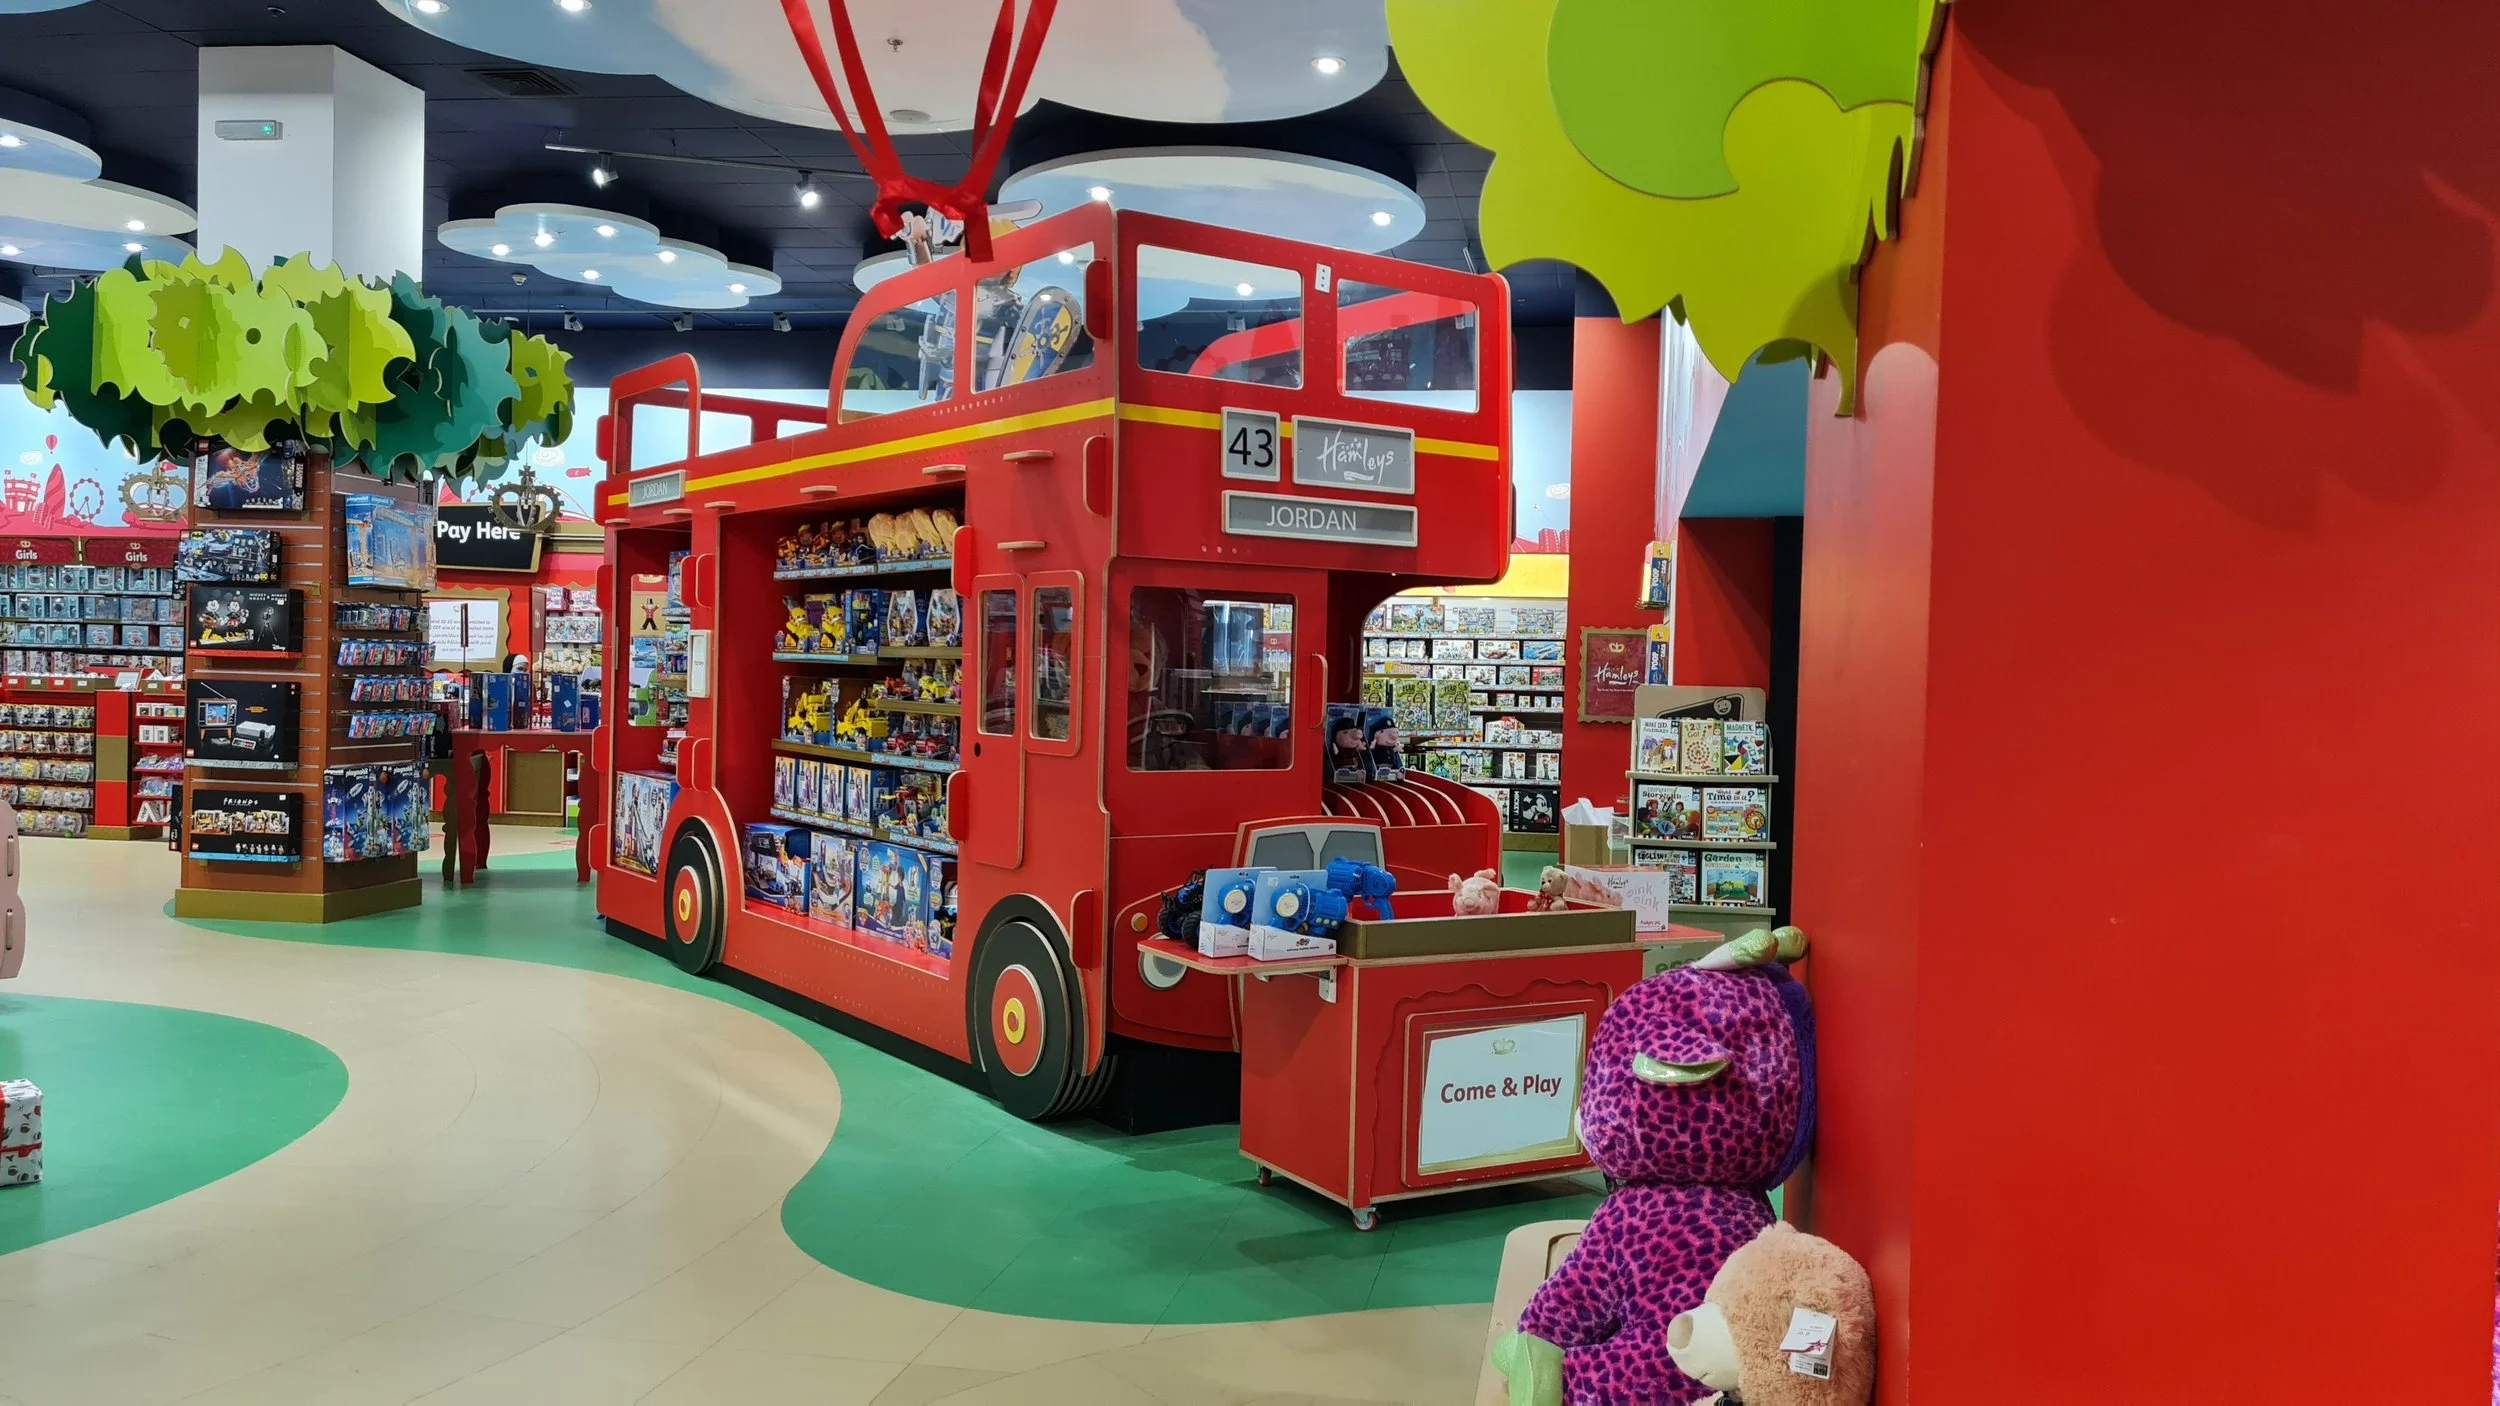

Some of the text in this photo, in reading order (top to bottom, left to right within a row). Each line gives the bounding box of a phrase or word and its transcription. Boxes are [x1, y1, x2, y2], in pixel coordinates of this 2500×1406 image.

[1228, 427, 1274, 468] 43
[1317, 428, 1395, 485] Hamleys
[295, 463, 304, 488] MARVEL
[642, 481, 668, 499] JORDAN
[1266, 506, 1357, 531] JORDAN
[437, 520, 521, 543] Pay Here
[15, 550, 38, 560] Girls
[125, 552, 148, 562] Girls
[1594, 662, 1639, 686] Hamleys
[223, 797, 259, 806] FRIENDS
[1704, 853, 1742, 863] Garden
[1627, 881, 1653, 898] oink
[1633, 896, 1661, 912] oink
[1441, 1074, 1562, 1104] Come & Play
